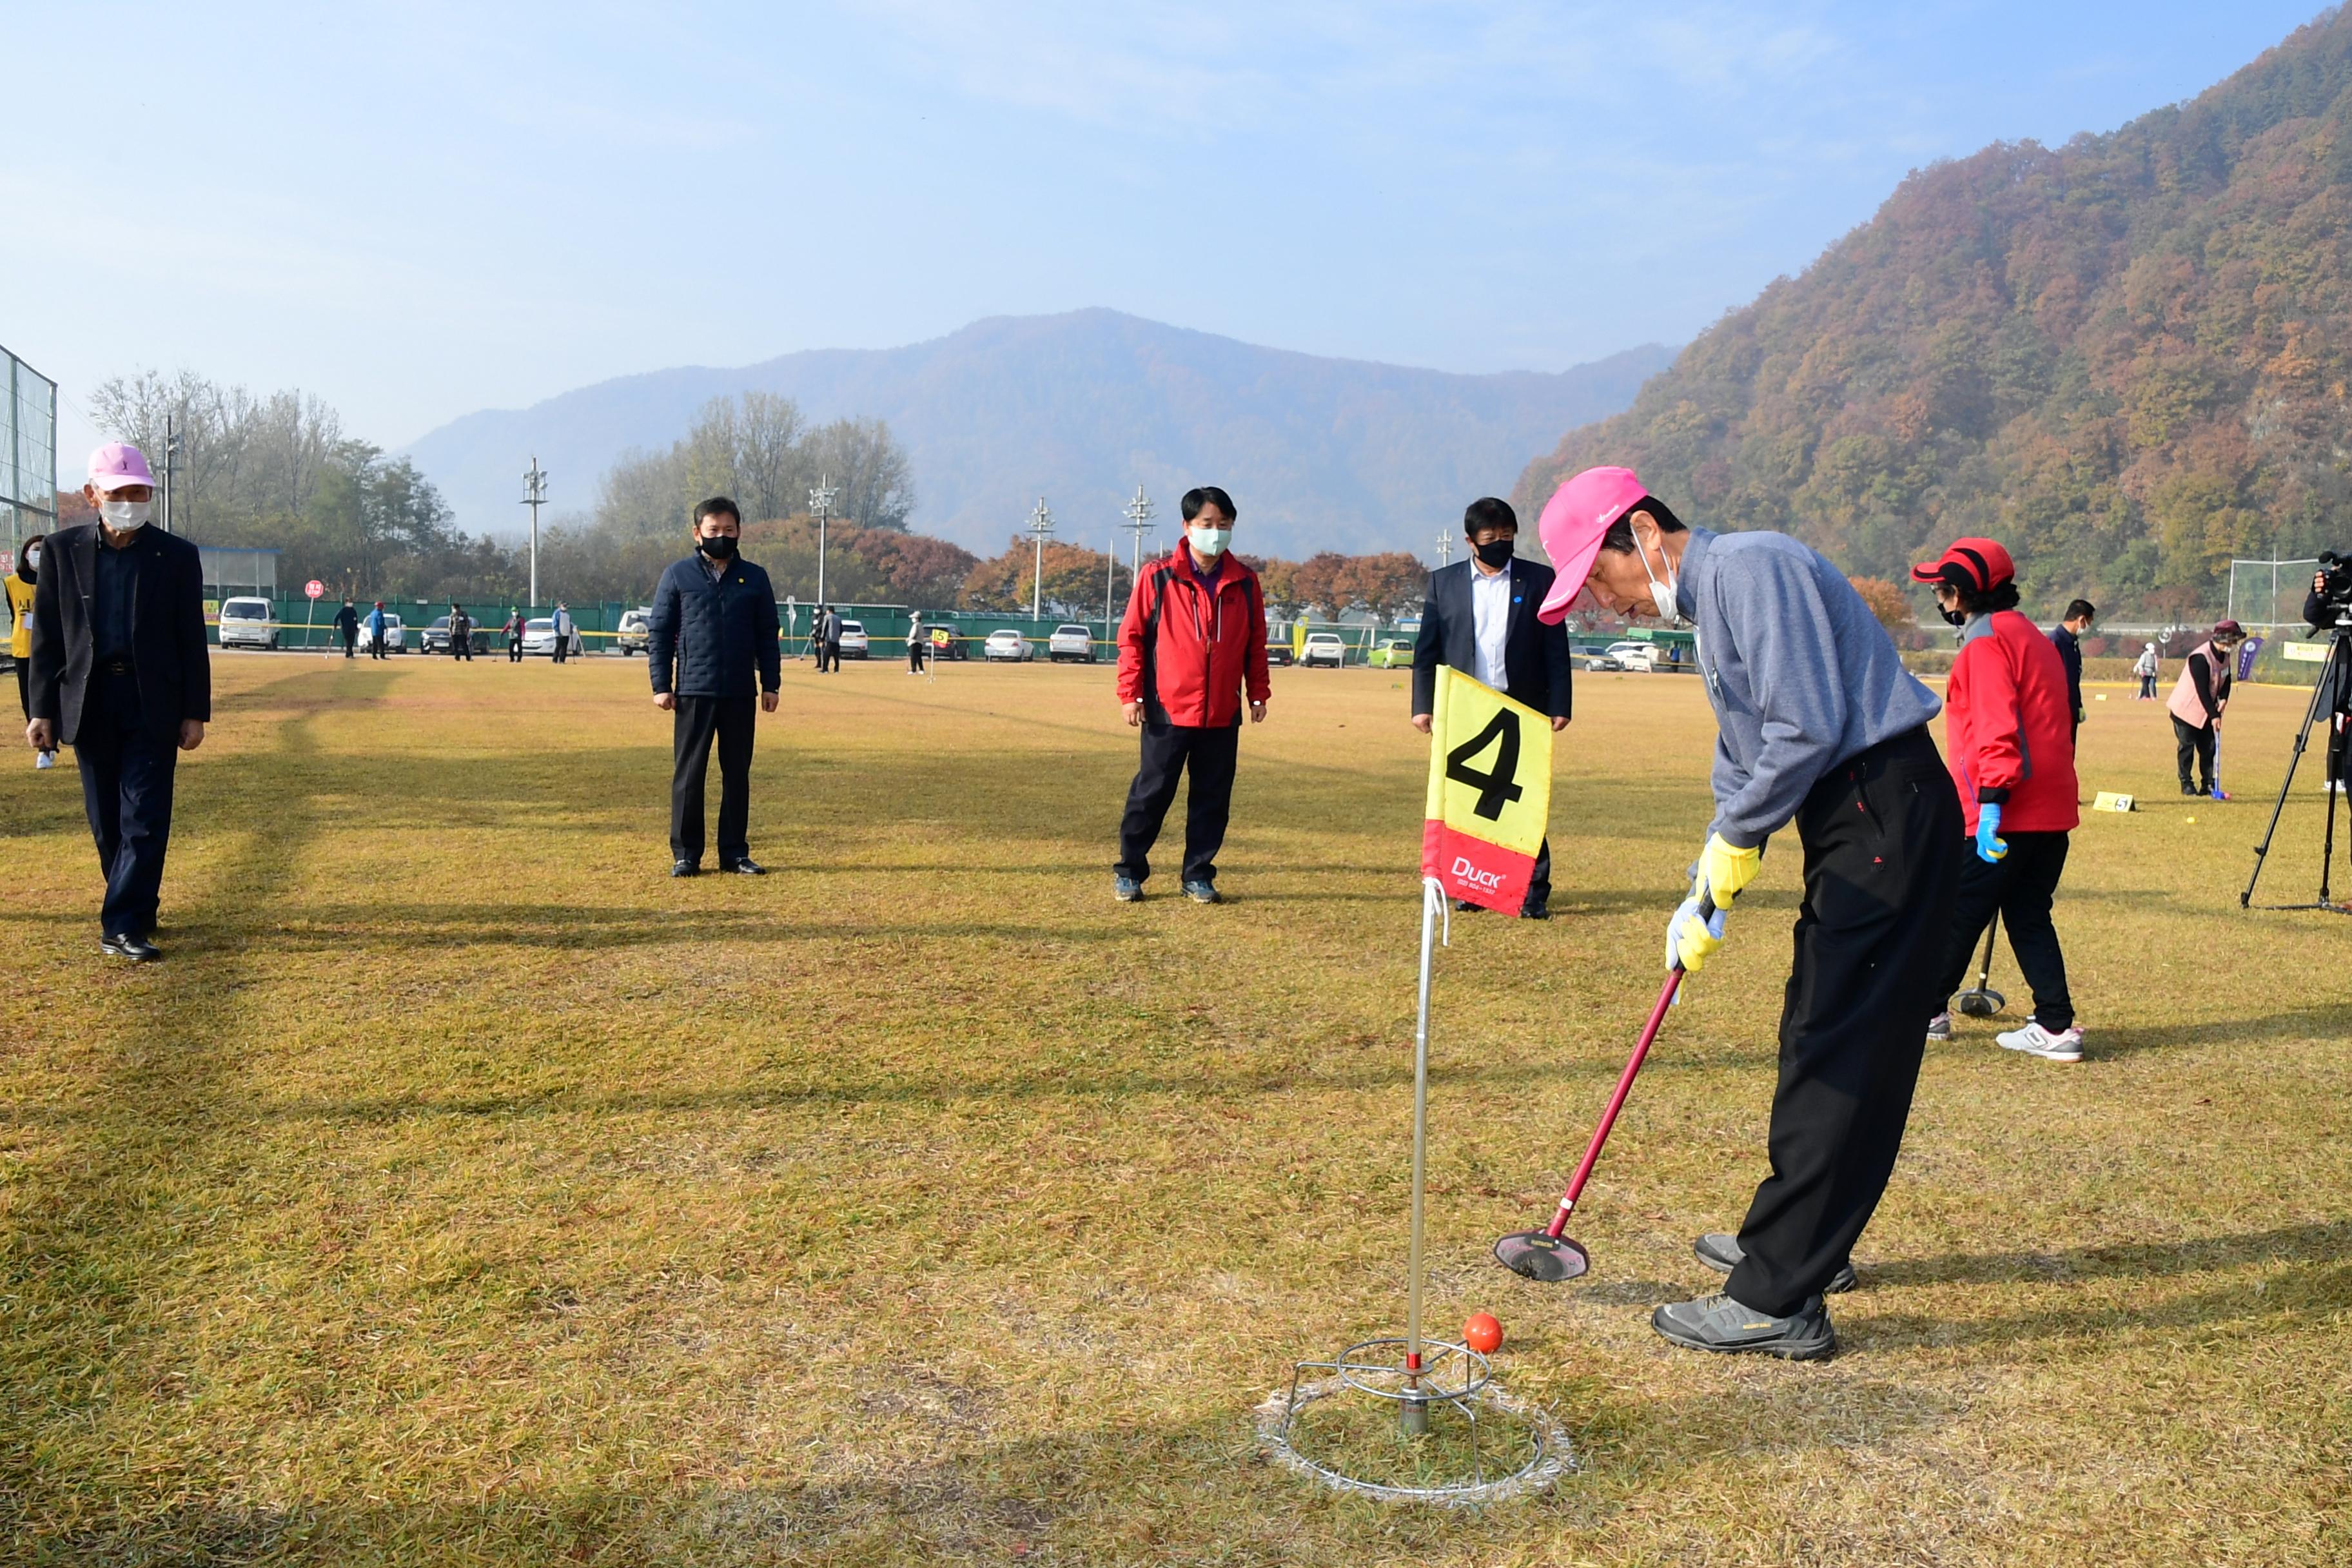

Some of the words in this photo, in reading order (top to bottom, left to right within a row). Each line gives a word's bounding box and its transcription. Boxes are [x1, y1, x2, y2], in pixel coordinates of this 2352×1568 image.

[937, 631, 945, 641] 5
[1446, 707, 1523, 821] 4
[2115, 796, 2127, 811] 5
